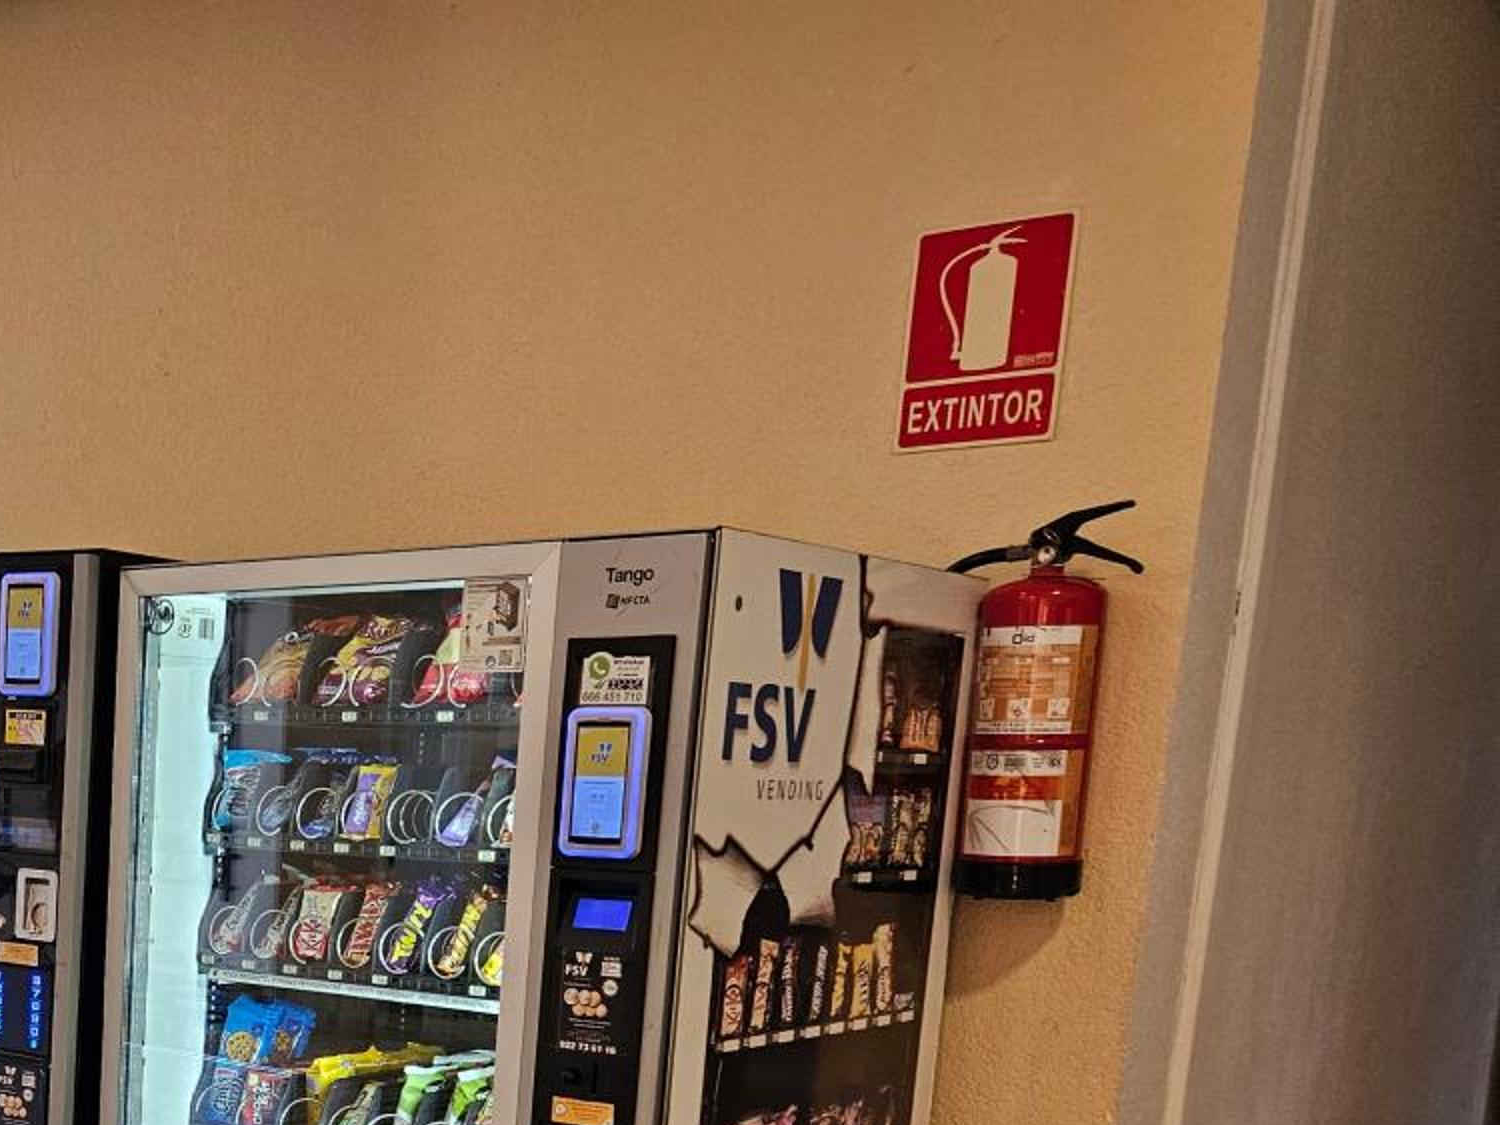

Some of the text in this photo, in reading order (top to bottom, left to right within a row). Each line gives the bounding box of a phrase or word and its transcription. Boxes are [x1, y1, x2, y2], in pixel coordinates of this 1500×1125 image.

[907, 389, 1043, 434] EXTINTOR
[605, 567, 655, 586] Tango
[625, 692, 642, 702] 710
[722, 681, 817, 764] FSV
[756, 779, 825, 801] VENDING
[564, 964, 589, 977] FSV
